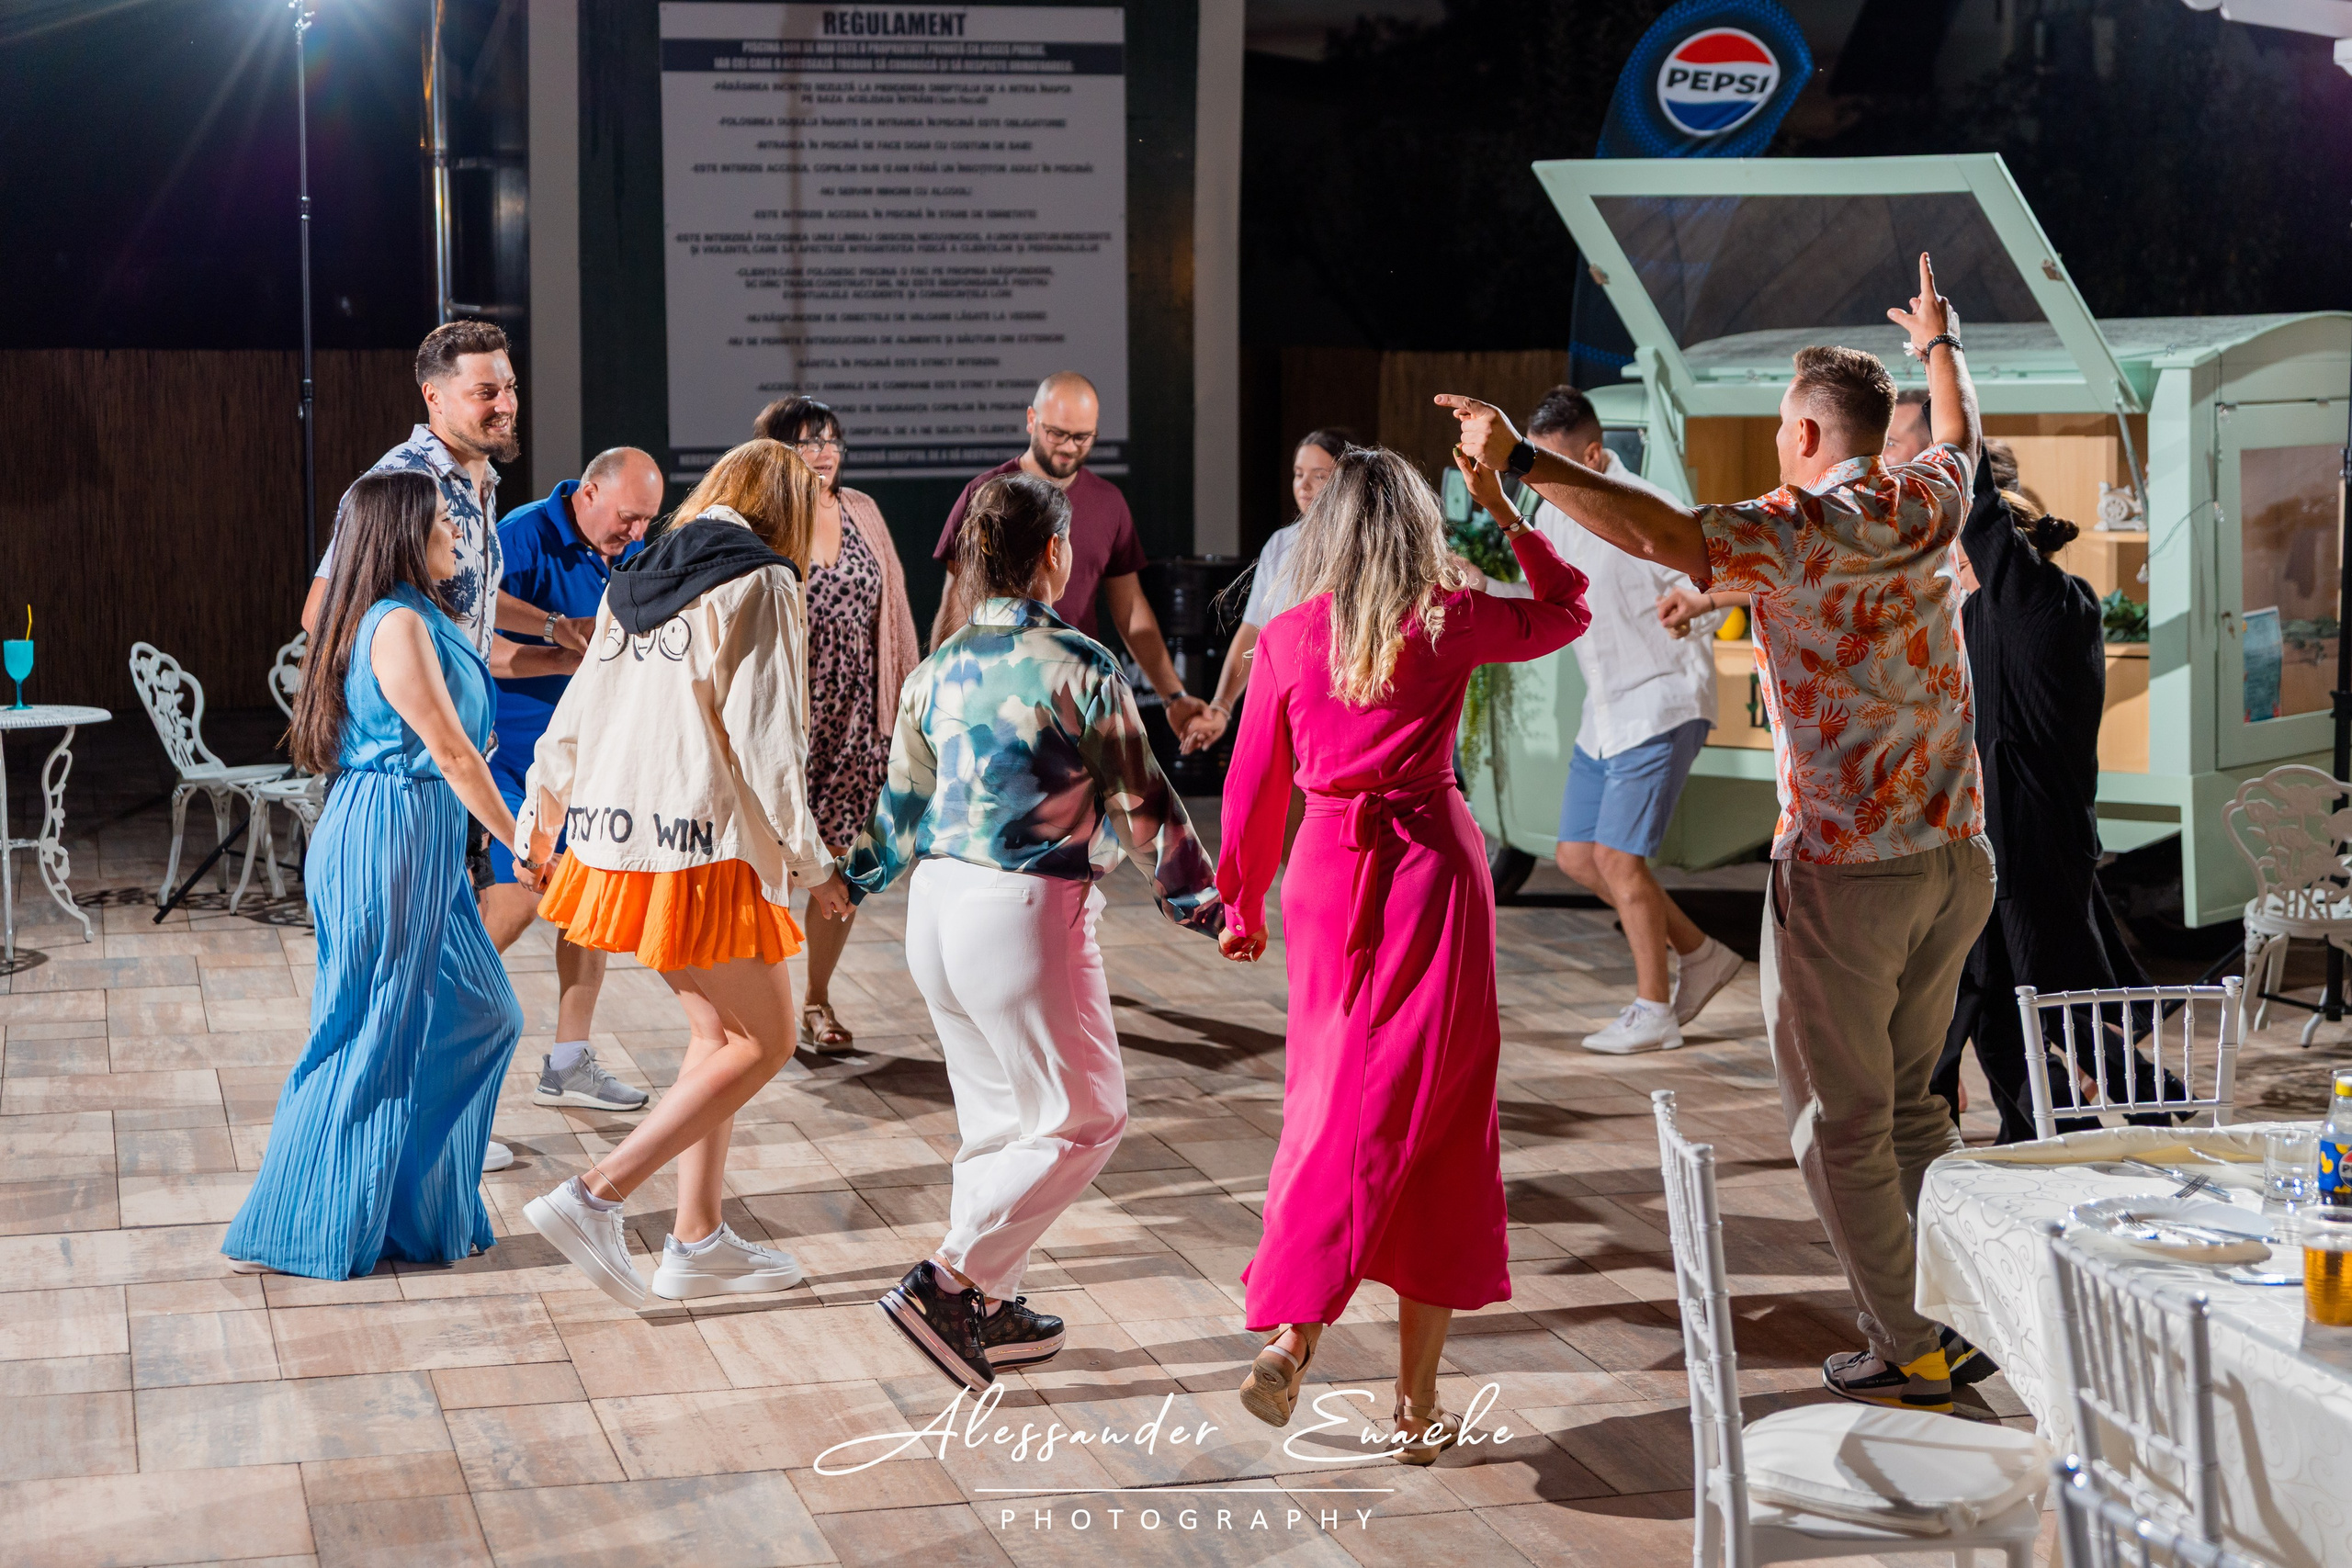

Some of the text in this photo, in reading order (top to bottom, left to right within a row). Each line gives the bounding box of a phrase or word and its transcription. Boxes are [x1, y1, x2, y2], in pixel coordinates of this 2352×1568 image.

[822, 11, 967, 37] REGULAMENT
[1667, 68, 1770, 94] PEPSI
[653, 813, 714, 856] WIN
